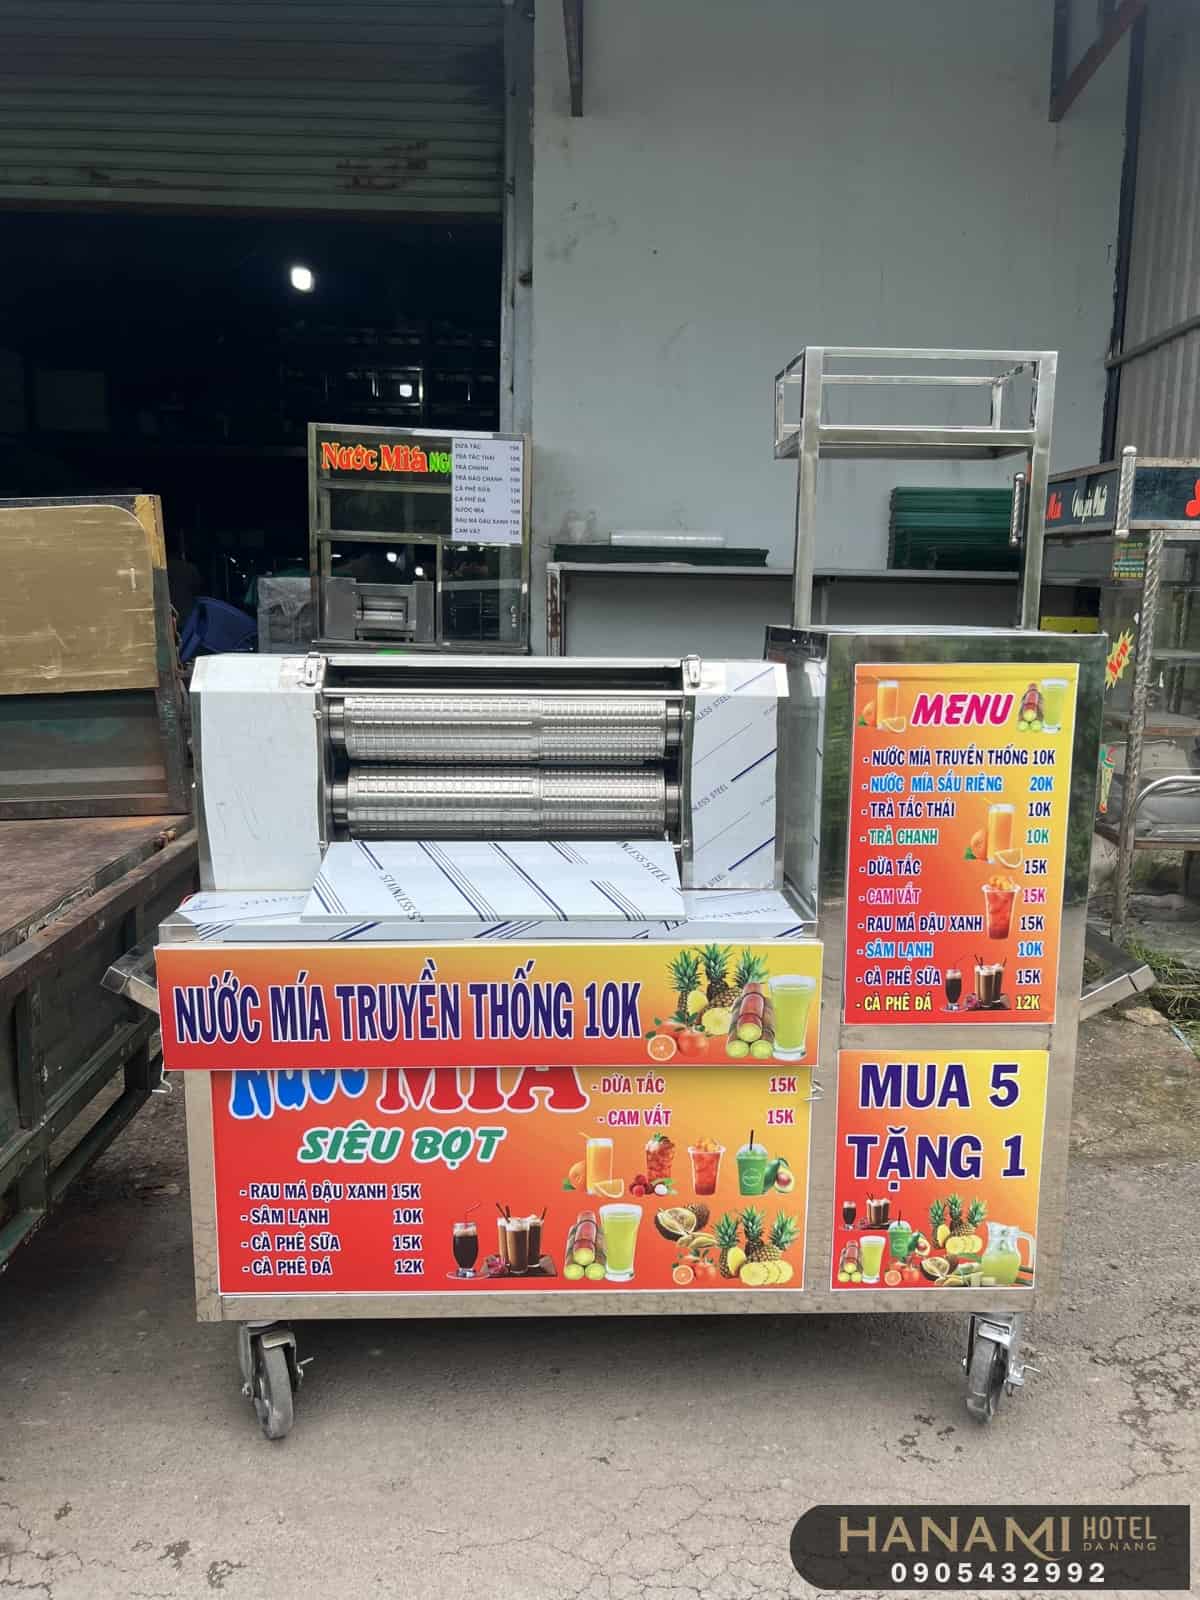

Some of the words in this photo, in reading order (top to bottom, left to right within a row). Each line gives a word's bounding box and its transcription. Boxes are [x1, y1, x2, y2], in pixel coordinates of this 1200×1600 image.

[911, 693, 1014, 726] MENU
[872, 747, 905, 766] NƯỚC
[909, 746, 931, 765] MÍA
[935, 744, 984, 765] TRUYỀN
[988, 744, 1028, 765] THỐNG
[1032, 750, 1055, 765] 10K
[871, 772, 904, 792] NƯỚC
[911, 772, 934, 792] MÍA
[965, 772, 1003, 792] RIÊNG
[1029, 776, 1053, 792] 20K
[870, 799, 894, 818] TRÀ
[927, 798, 955, 818] THÁI
[1028, 802, 1051, 818] 10K
[869, 827, 893, 845] TRÀ
[897, 829, 938, 845] CHANH
[1026, 829, 1049, 844] 10K
[867, 857, 893, 875] DỪA
[1024, 860, 1047, 874] 15K
[866, 889, 892, 904] CAM
[1023, 888, 1046, 904] 15K
[867, 916, 892, 932] RAU
[896, 912, 916, 932] MÁ
[919, 912, 945, 936] ĐẬU
[949, 916, 983, 932] XANH
[1020, 916, 1044, 931] 15K
[866, 938, 895, 957] SÂM
[898, 942, 933, 961] LẠNH
[1017, 942, 1043, 956] 10K
[865, 967, 882, 985] CÀ
[886, 967, 911, 985] PHÊ
[916, 967, 941, 985] SỮA
[1016, 970, 1041, 984] 15K
[174, 971, 261, 1043] NƯỚC
[269, 971, 329, 1041] MÍA
[336, 958, 461, 1040] TRUYỀN
[469, 959, 573, 1039] THỐNG
[584, 982, 641, 1038] 10K
[864, 993, 881, 1011] CÀ
[885, 993, 909, 1011] PHÊ
[915, 993, 932, 1011] ĐÁ
[1016, 996, 1040, 1010] 12K
[602, 1073, 631, 1094] DỪA
[636, 1072, 665, 1094] TẮC
[769, 1077, 798, 1093] 15K
[860, 1063, 971, 1108] MUA
[989, 1063, 1020, 1108] 5
[608, 1110, 639, 1126] CAM
[644, 1104, 671, 1126] VẮT
[767, 1109, 794, 1125] 15K
[298, 1119, 404, 1163] SIÊU
[412, 1127, 507, 1169] BỌT
[847, 1126, 982, 1192] TẶNG
[1001, 1134, 1027, 1178] 1
[250, 1183, 279, 1199] RAU
[284, 1179, 307, 1199] MÁ
[312, 1179, 343, 1203] ĐẬU
[348, 1184, 387, 1199] XANH
[392, 1183, 421, 1199] 15K
[251, 1204, 283, 1224] SÂM
[289, 1208, 329, 1227] LẠNH
[394, 1208, 422, 1224] 10K
[251, 1231, 271, 1251] CÀ
[276, 1231, 305, 1251] PHÊ
[310, 1232, 340, 1251] SỮA
[393, 1235, 422, 1250] 15K
[253, 1256, 272, 1275] CÀ
[277, 1256, 306, 1275] PHÊ
[311, 1256, 332, 1275] ĐÁ
[395, 1260, 423, 1274] 12K
